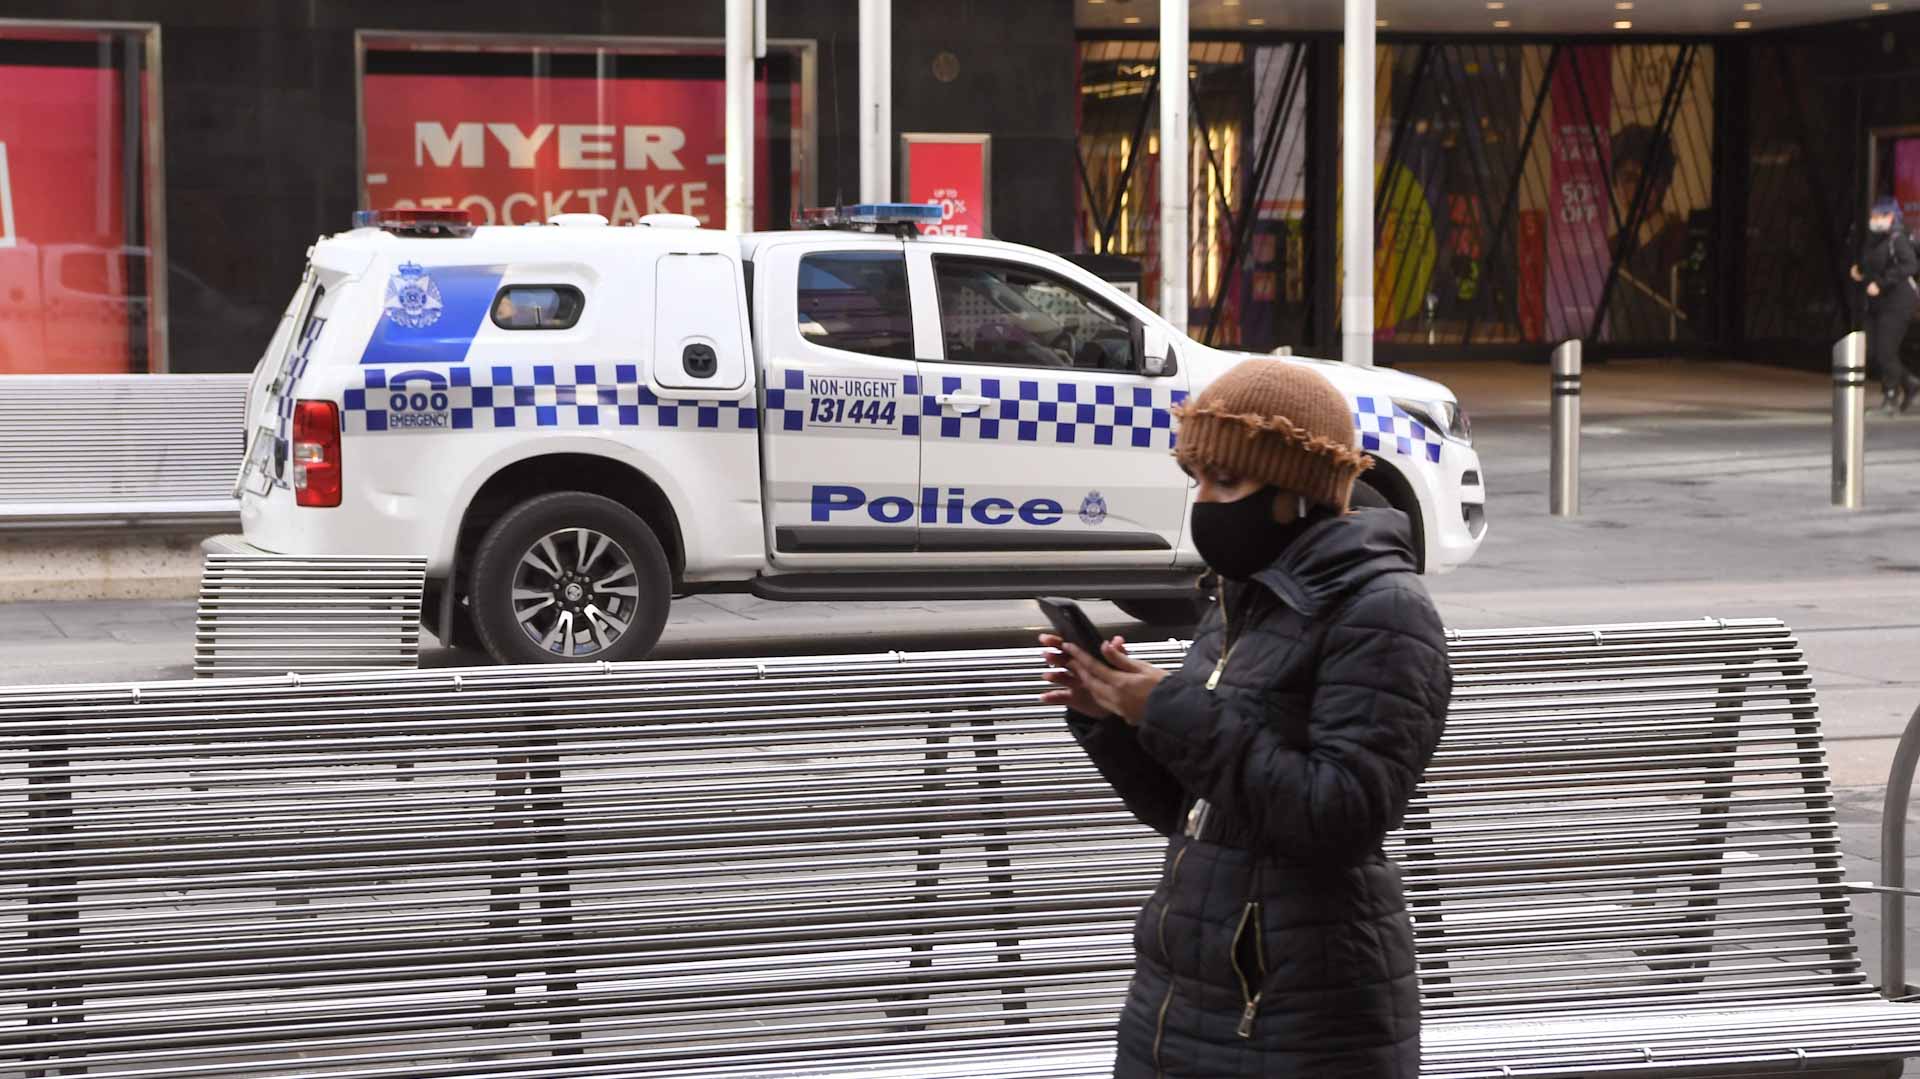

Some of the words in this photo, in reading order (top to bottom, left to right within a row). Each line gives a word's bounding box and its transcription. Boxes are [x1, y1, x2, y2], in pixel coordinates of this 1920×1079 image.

[414, 121, 686, 171] MYER
[927, 199, 966, 220] 0%
[810, 379, 897, 398] NON-URGENT
[390, 393, 448, 411] 000
[810, 398, 845, 423] 131
[847, 400, 896, 425] 444
[390, 414, 448, 427] EMERGENCY
[811, 485, 1064, 526] Police
